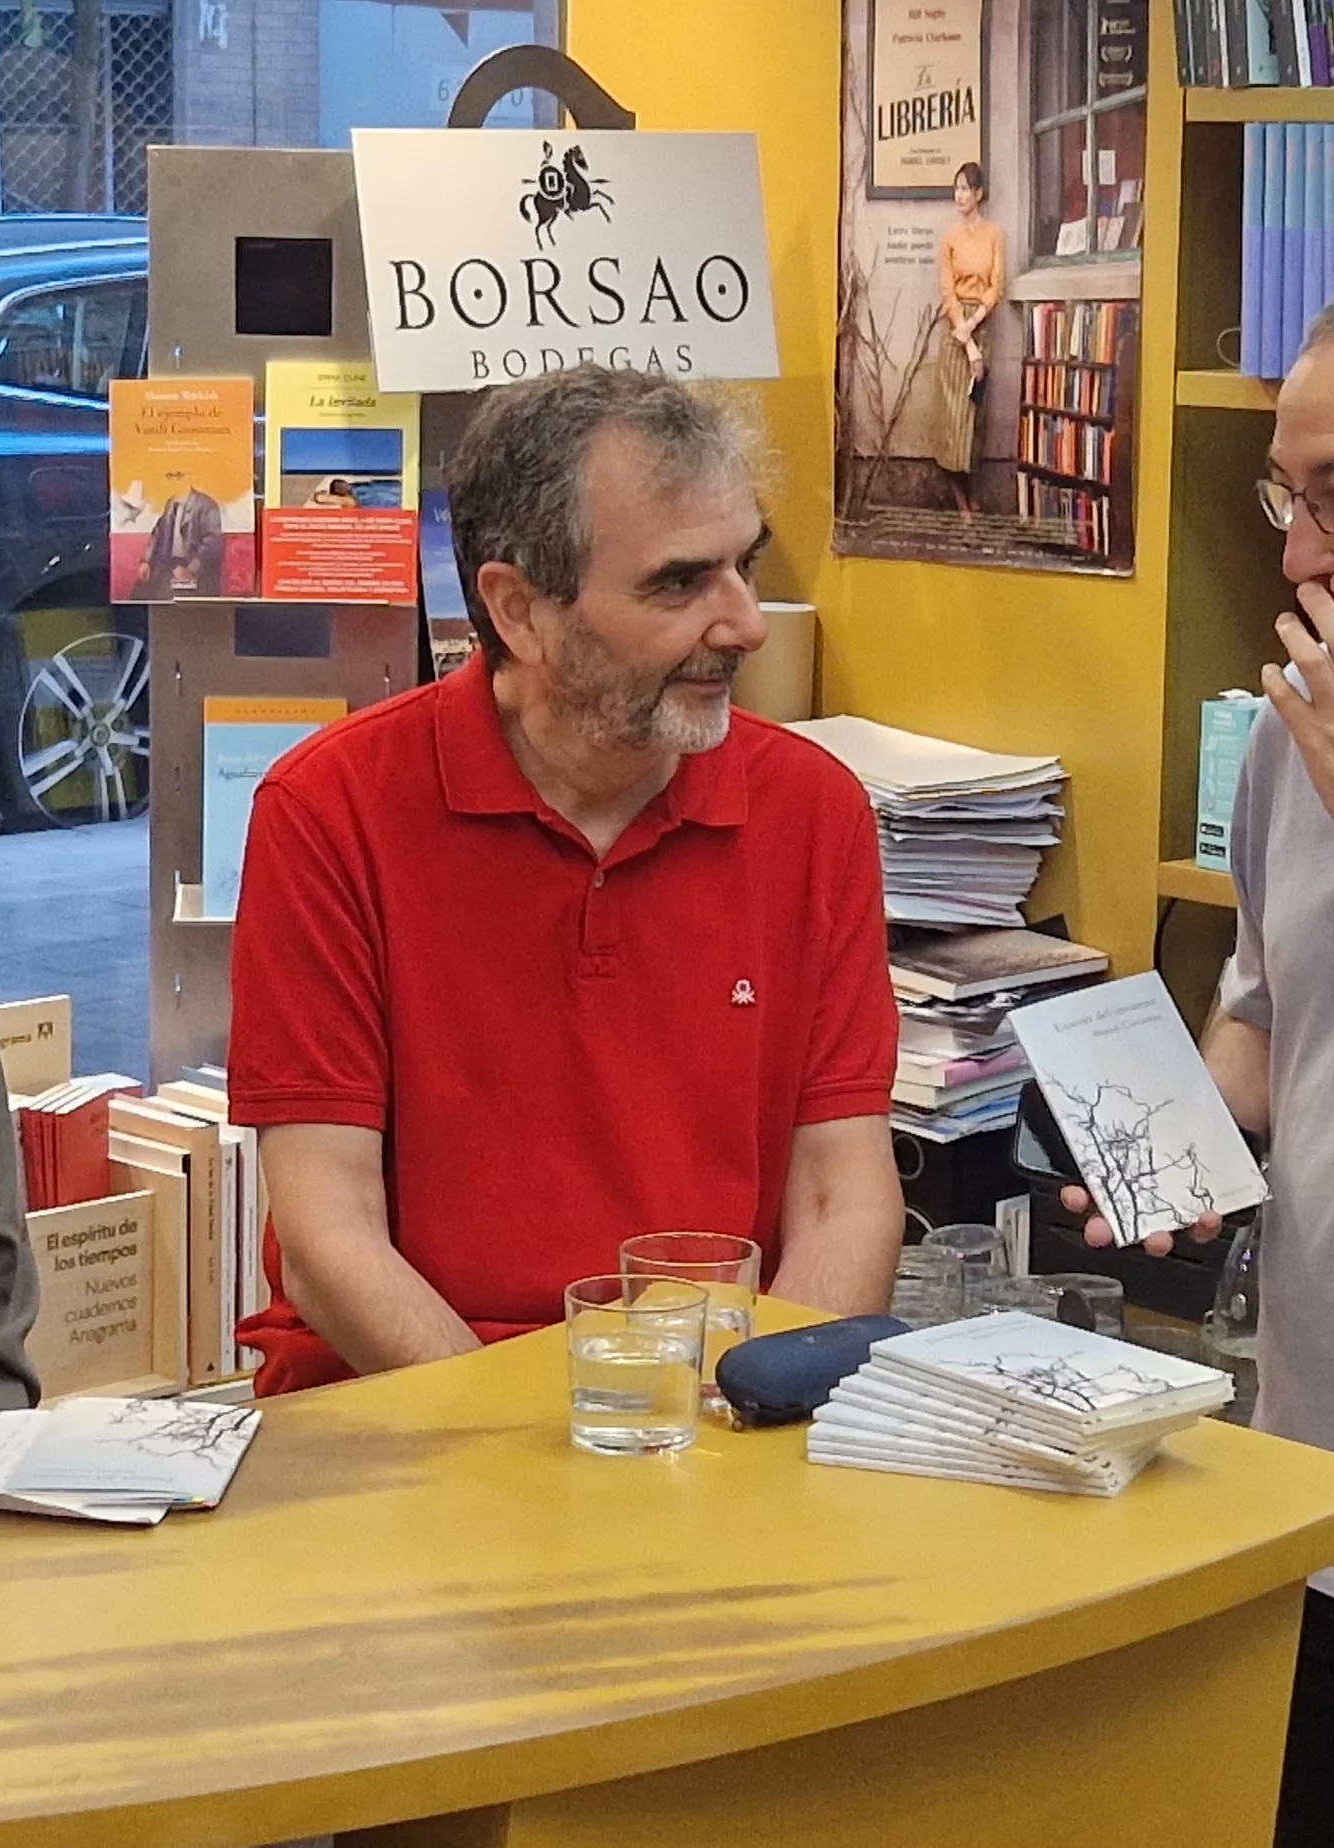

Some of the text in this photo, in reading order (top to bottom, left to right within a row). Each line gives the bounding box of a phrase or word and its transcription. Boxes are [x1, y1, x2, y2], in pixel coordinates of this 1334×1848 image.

[878, 76, 976, 141] LIBRERÍA
[389, 254, 750, 330] BORSAO
[471, 345, 694, 380] BODEGAS
[309, 396, 325, 408] La
[47, 1218, 138, 1251] El espíritu de
[54, 1243, 137, 1272] los tiempos
[85, 1274, 137, 1296] Nuevos
[64, 1297, 137, 1323] cuadernos
[69, 1319, 137, 1345] Anagrama
